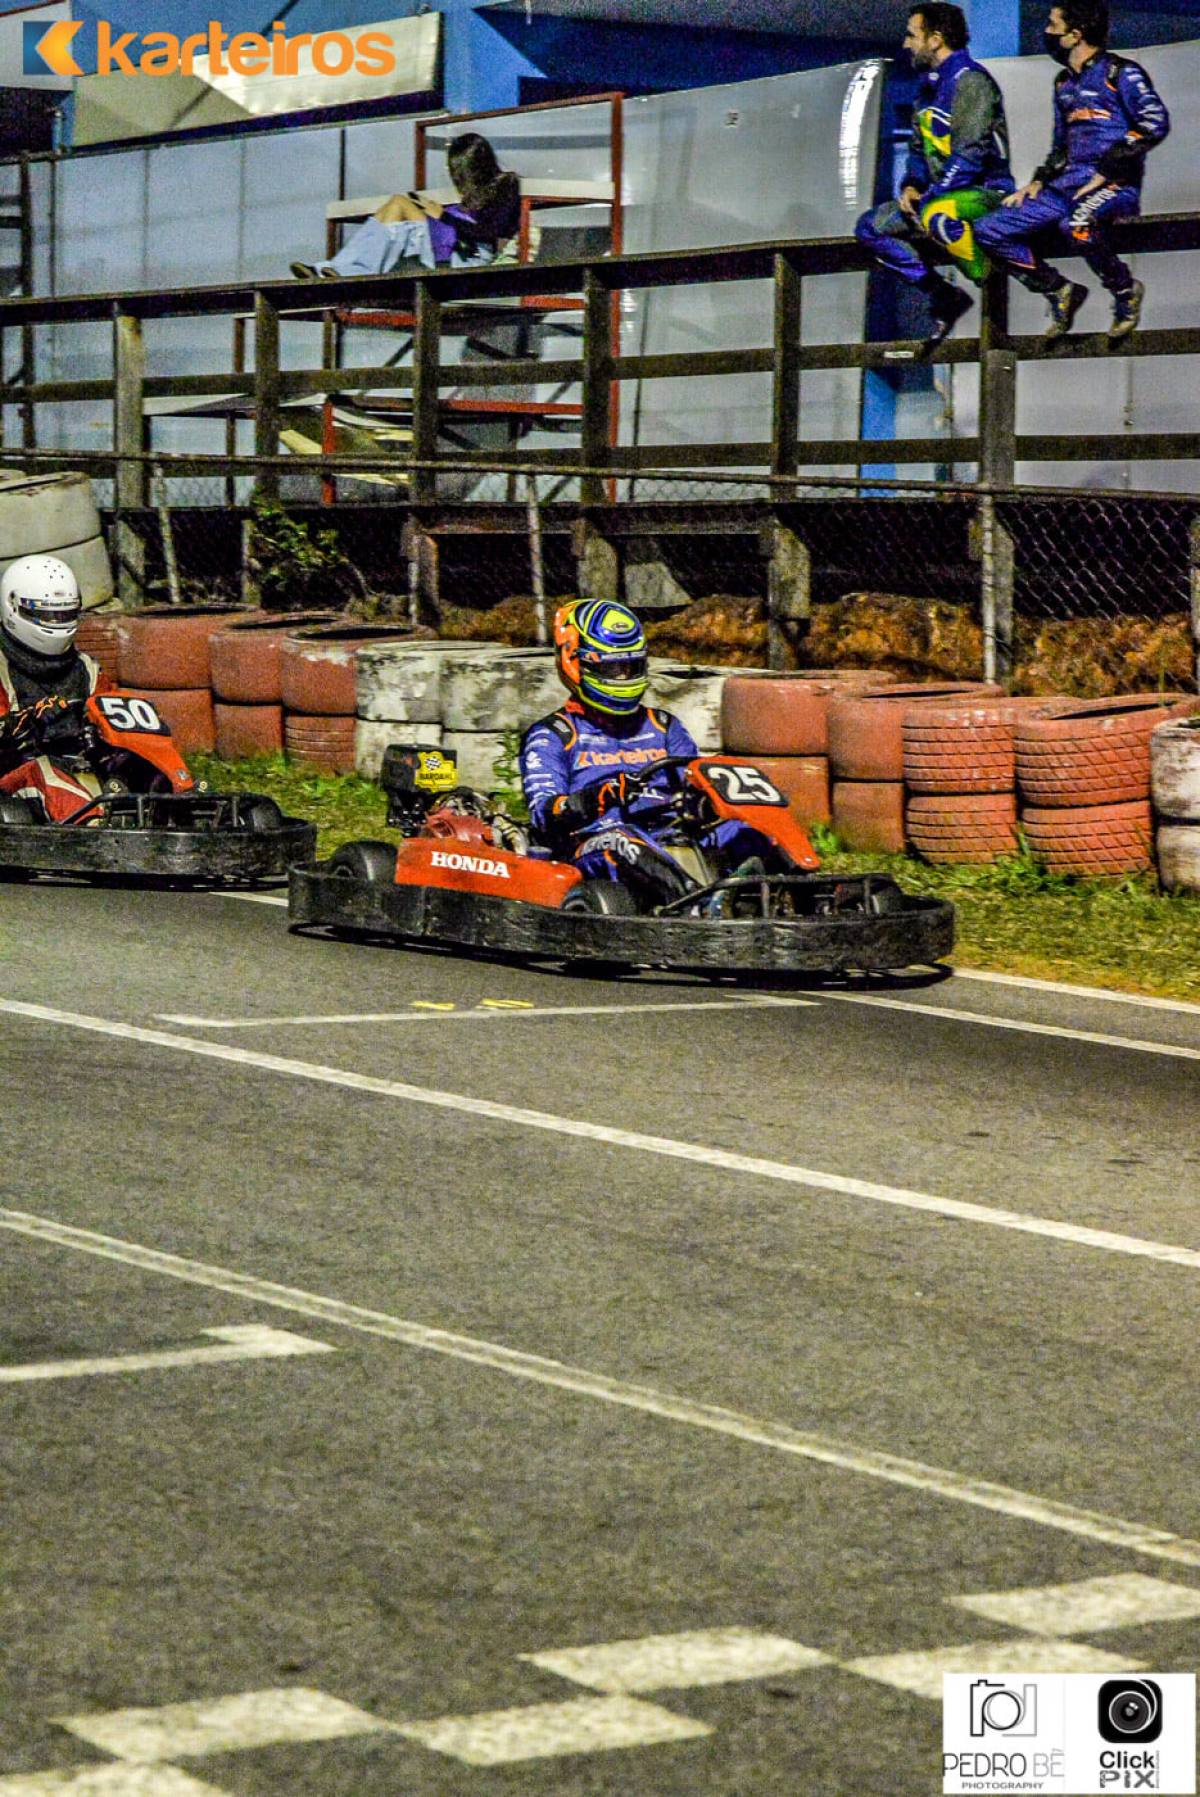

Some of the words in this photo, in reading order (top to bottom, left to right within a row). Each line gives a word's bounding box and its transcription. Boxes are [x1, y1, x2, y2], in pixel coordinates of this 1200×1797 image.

[101, 697, 160, 730] 50
[706, 766, 781, 802] 25
[431, 850, 511, 878] HONDA
